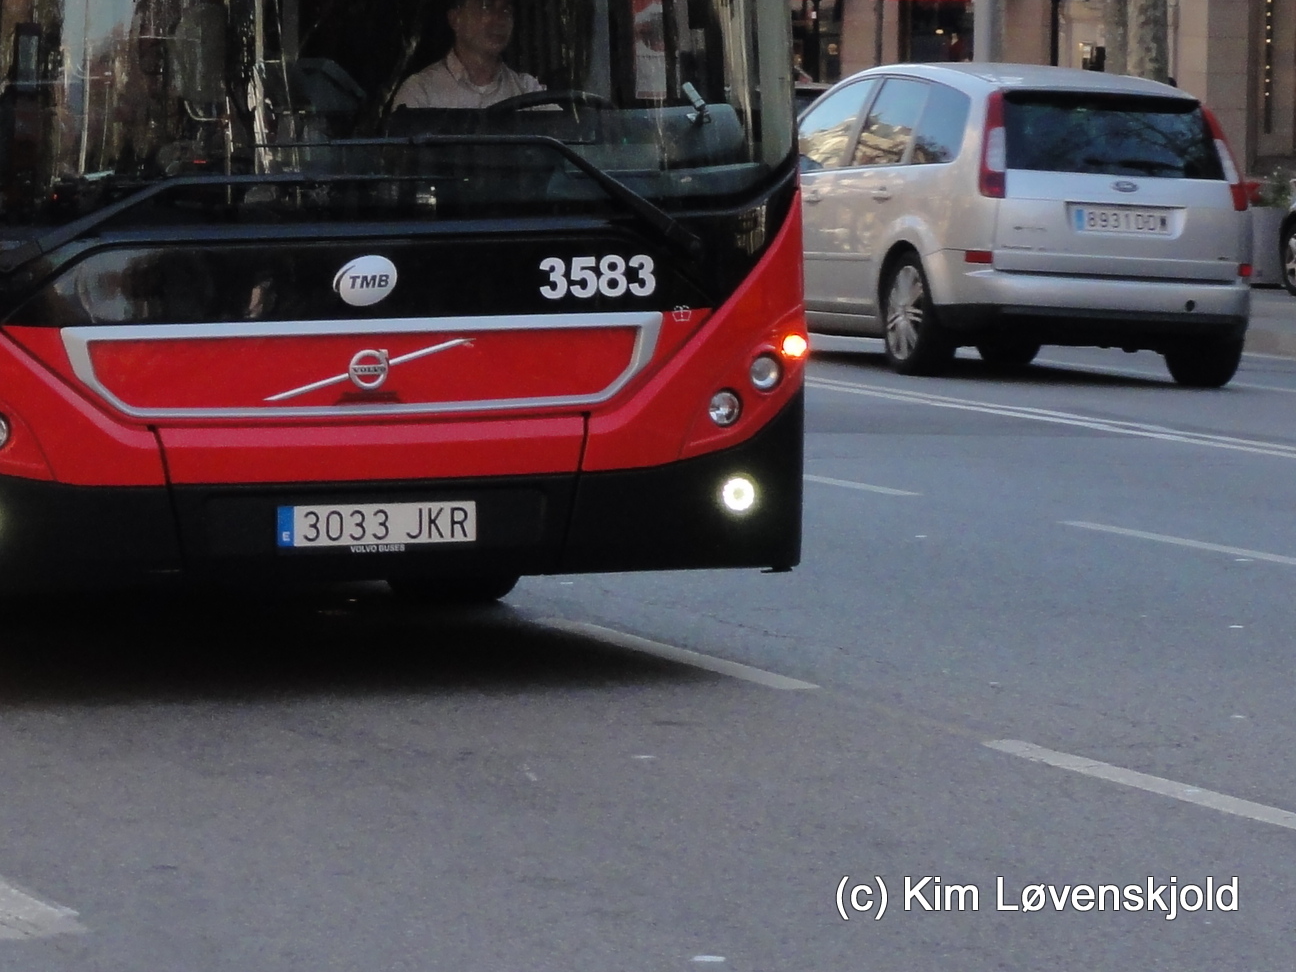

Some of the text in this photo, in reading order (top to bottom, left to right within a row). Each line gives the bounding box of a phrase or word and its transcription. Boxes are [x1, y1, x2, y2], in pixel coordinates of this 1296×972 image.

[1088, 211, 1131, 230] 8931
[349, 274, 390, 289] TMB
[539, 254, 656, 299] 3583
[352, 365, 387, 374] VOLVO
[303, 507, 469, 542] 3033 JKR
[282, 532, 291, 541] E
[350, 543, 405, 553] VOLVO BUSES
